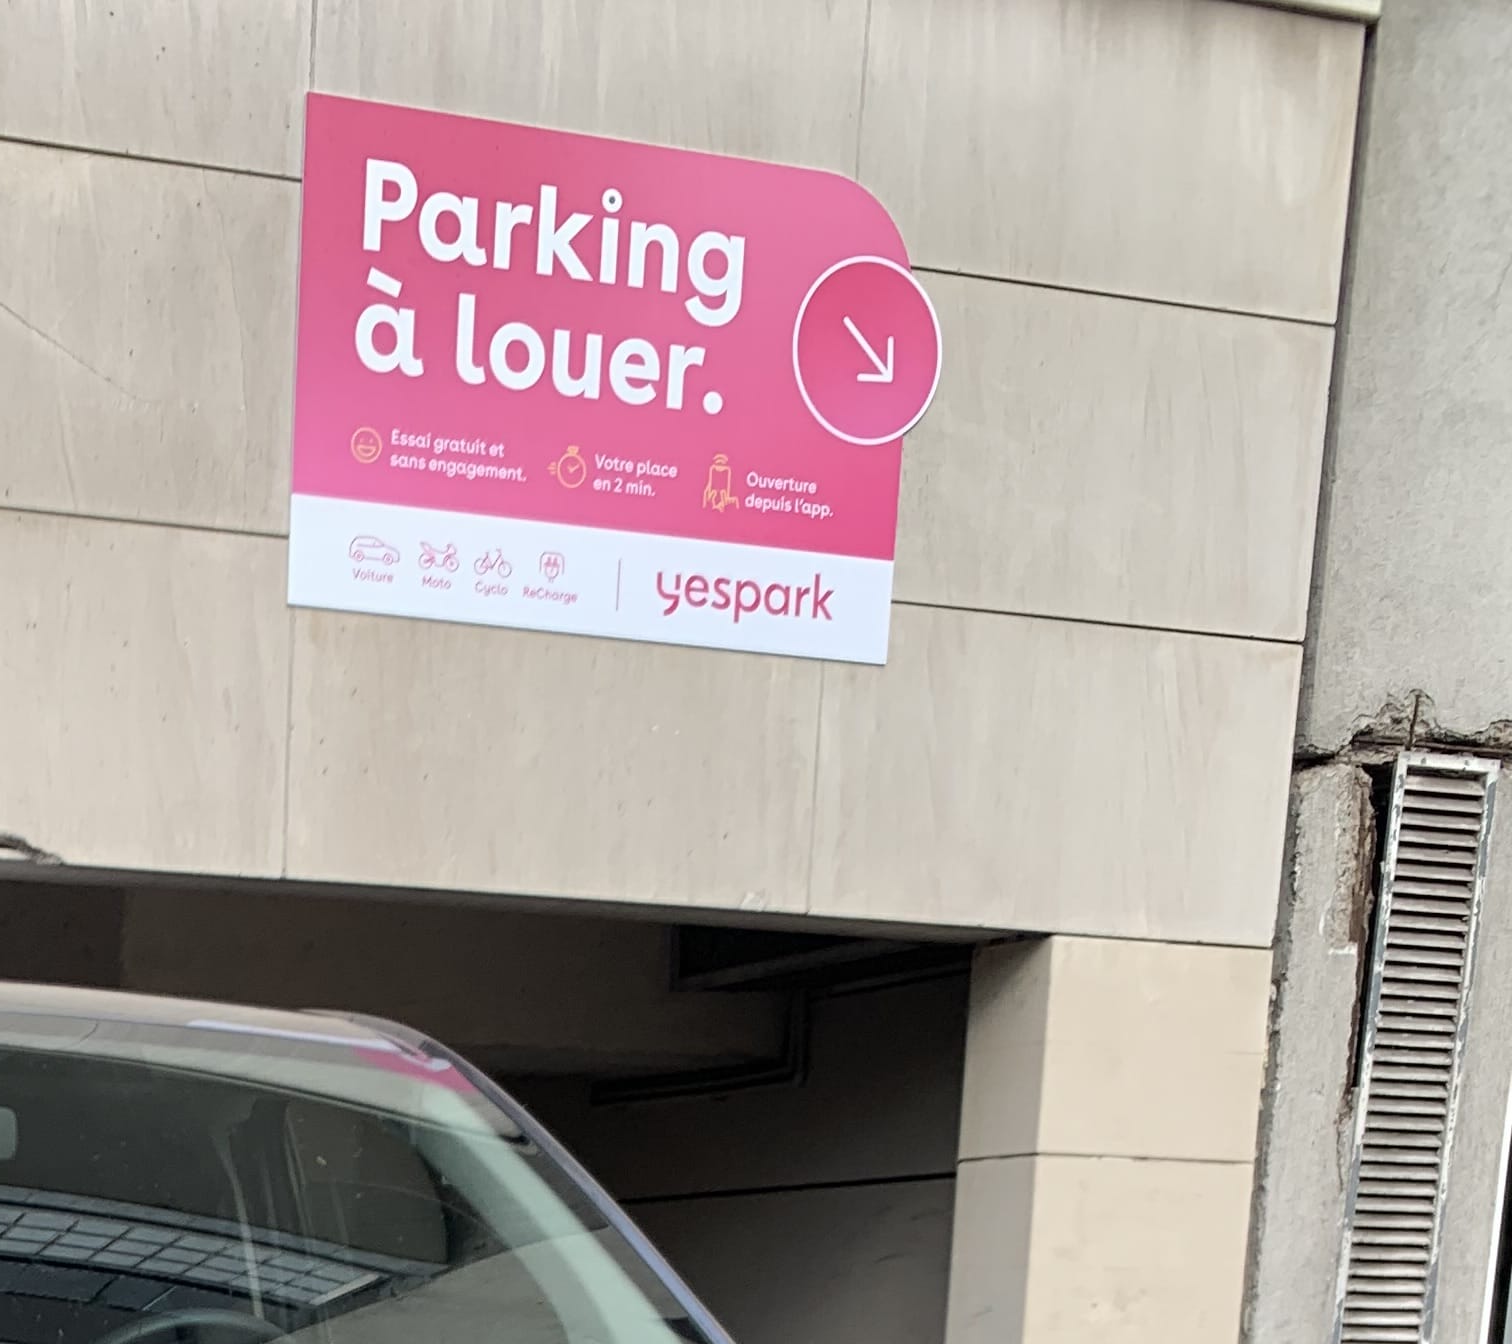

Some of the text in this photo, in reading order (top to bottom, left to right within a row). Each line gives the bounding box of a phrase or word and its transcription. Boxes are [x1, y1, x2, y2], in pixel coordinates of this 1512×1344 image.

[362, 158, 746, 327] Parking
[355, 267, 724, 415] à louer.
[391, 428, 505, 458] Essai gratuit et
[390, 453, 528, 482] sans engagement.
[594, 454, 678, 478] Votre place
[593, 477, 656, 497] en 2 min.
[745, 471, 817, 494] Ouverture
[744, 494, 834, 519] depuis l'app.
[352, 568, 394, 583] Voiture
[421, 575, 452, 590] Moto
[474, 581, 508, 597] Cyclo
[522, 585, 578, 605] ReCharge
[656, 571, 835, 624] yespark
